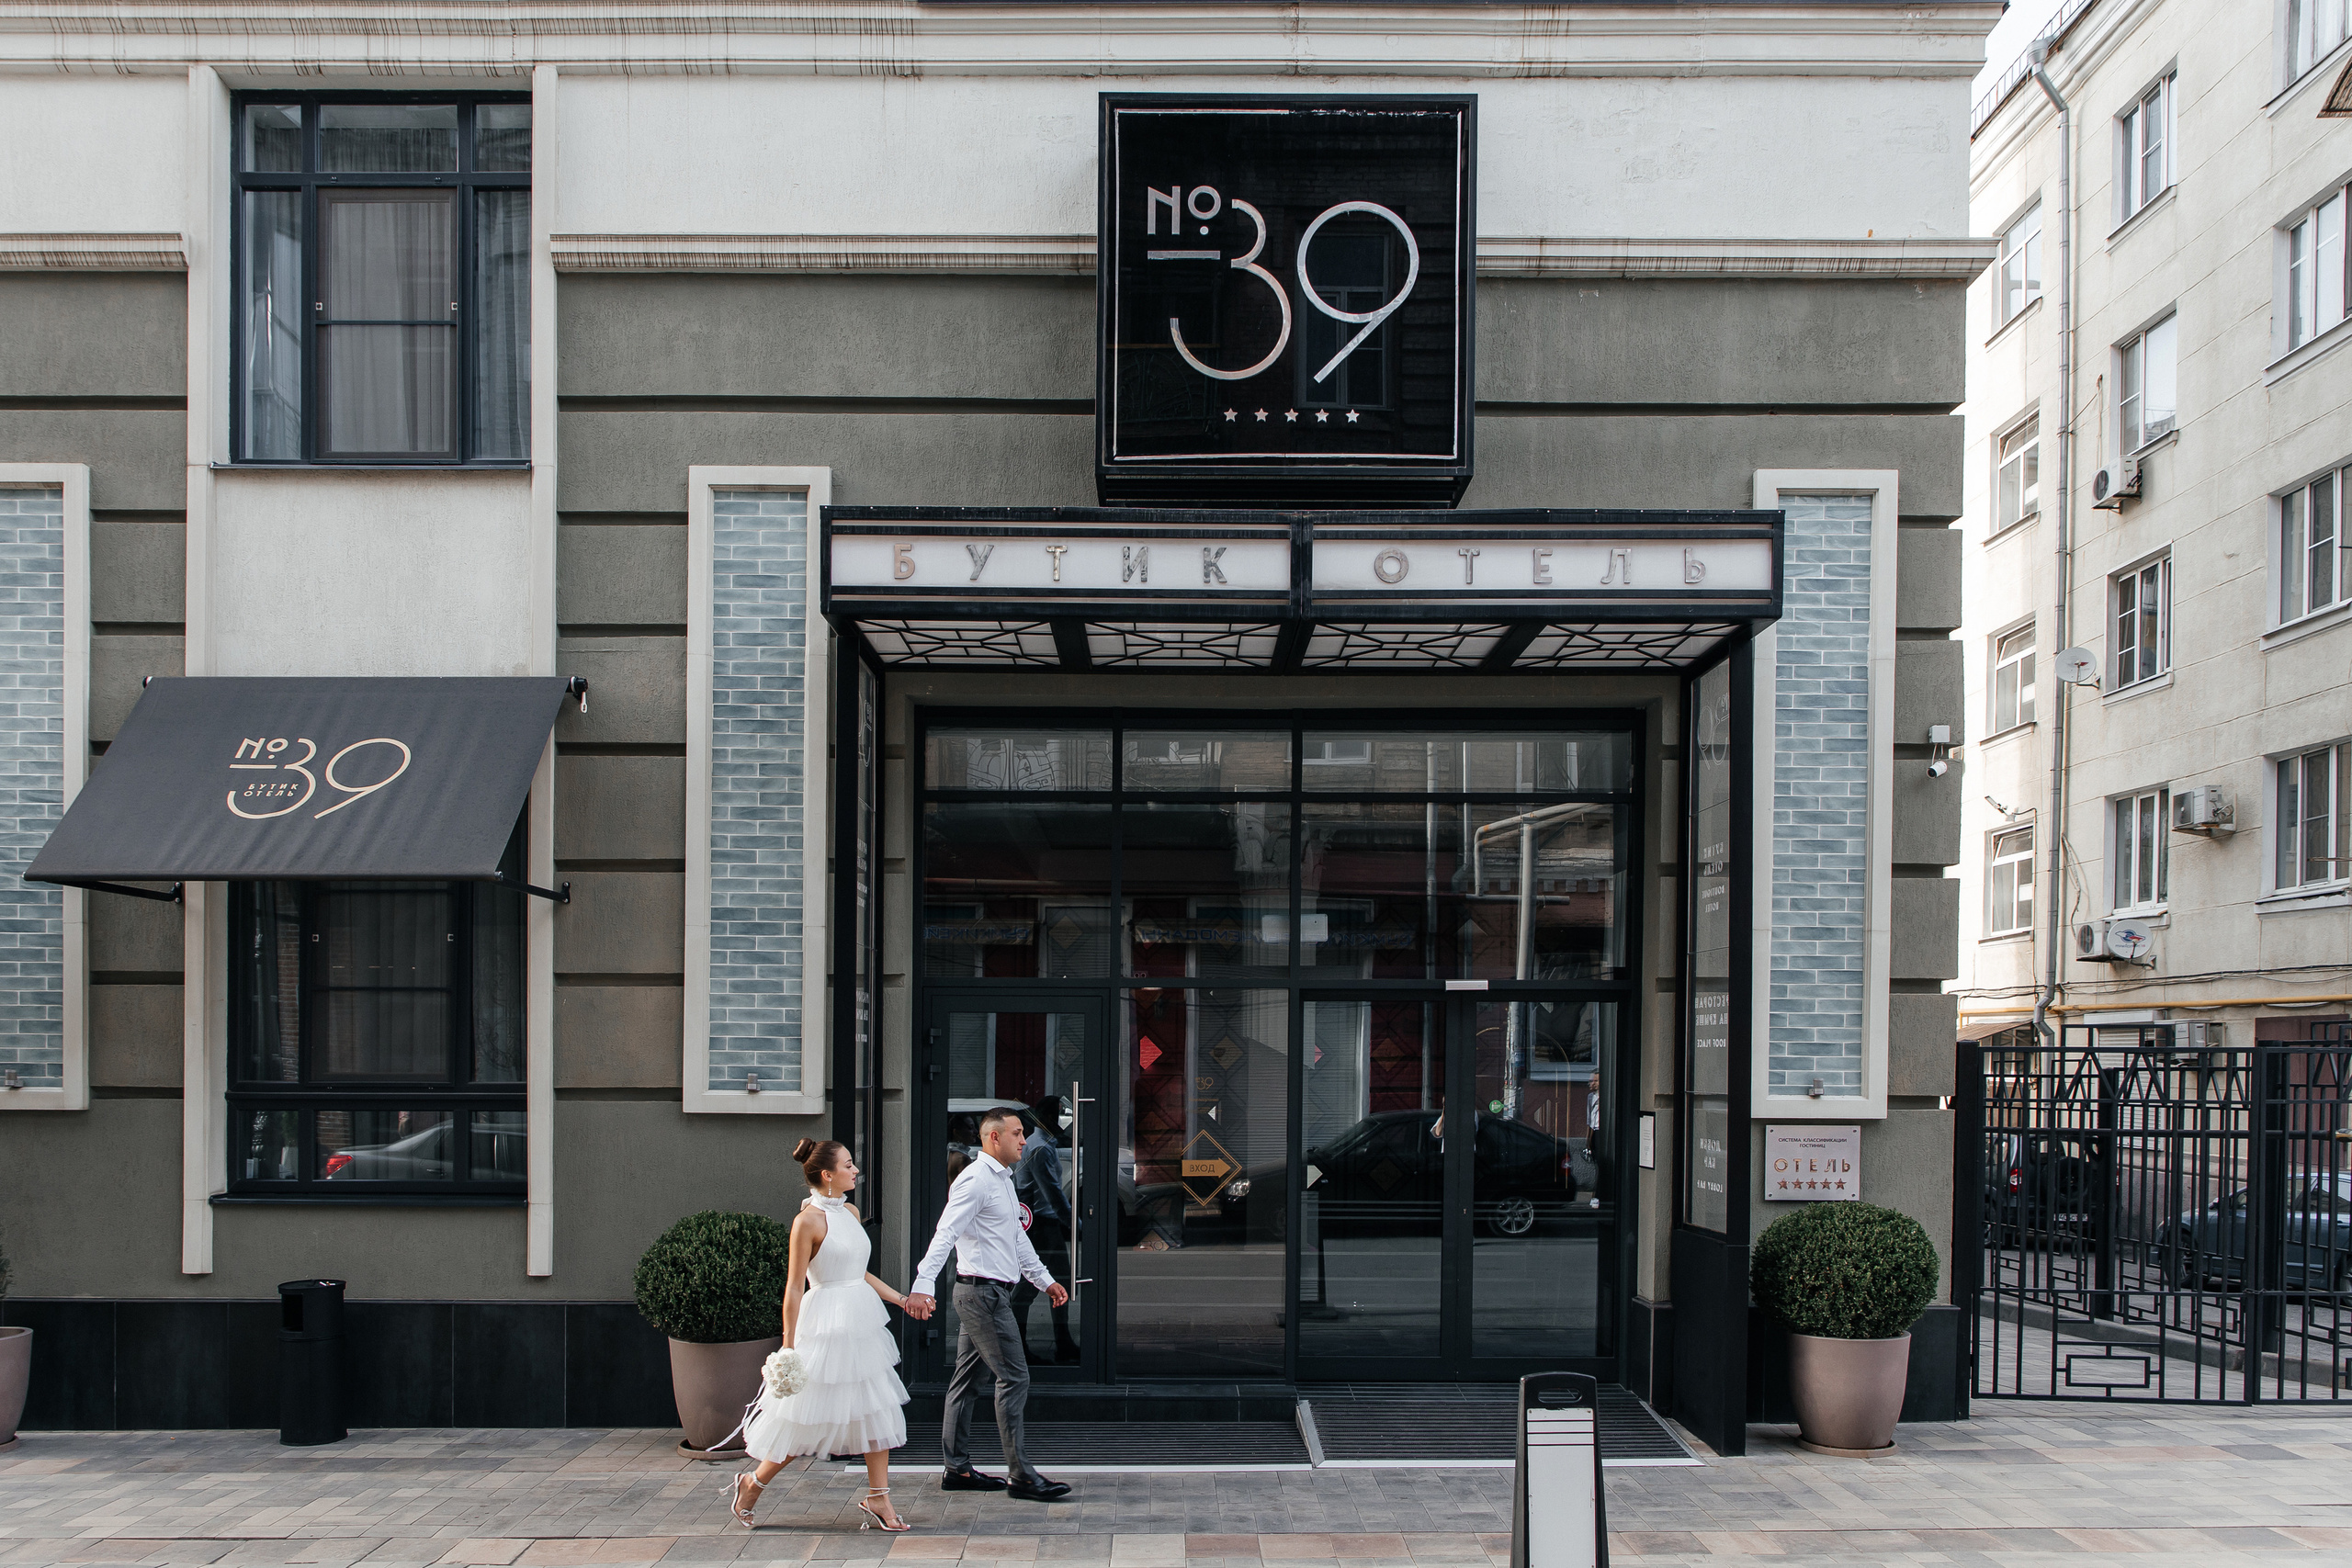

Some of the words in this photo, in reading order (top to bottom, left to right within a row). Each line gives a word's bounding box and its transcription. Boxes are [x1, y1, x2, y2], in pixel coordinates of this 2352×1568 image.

[1170, 198, 1419, 383] 39
[893, 544, 1227, 583] БУТИК
[1374, 547, 1707, 584] ОТЕЛЬ
[226, 738, 412, 819] 39
[1190, 1164, 1216, 1173] ВХОД
[1773, 1158, 1851, 1173] ОТЕЛЬ
